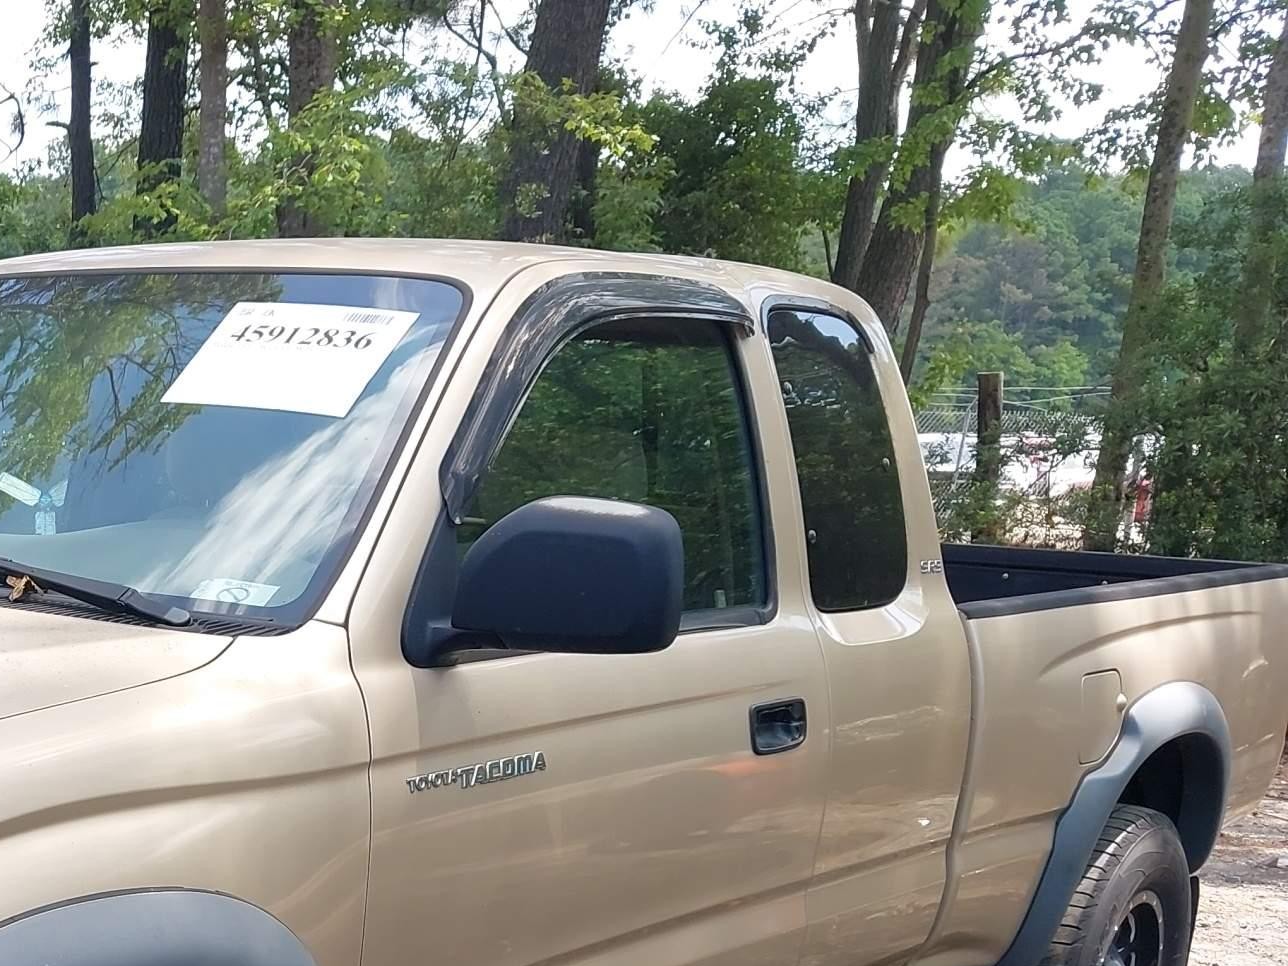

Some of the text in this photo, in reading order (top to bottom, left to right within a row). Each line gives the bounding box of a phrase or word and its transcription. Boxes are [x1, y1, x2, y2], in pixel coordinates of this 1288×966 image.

[231, 325, 376, 350] 45912836
[406, 750, 547, 794] TOYOTA TACOMA
